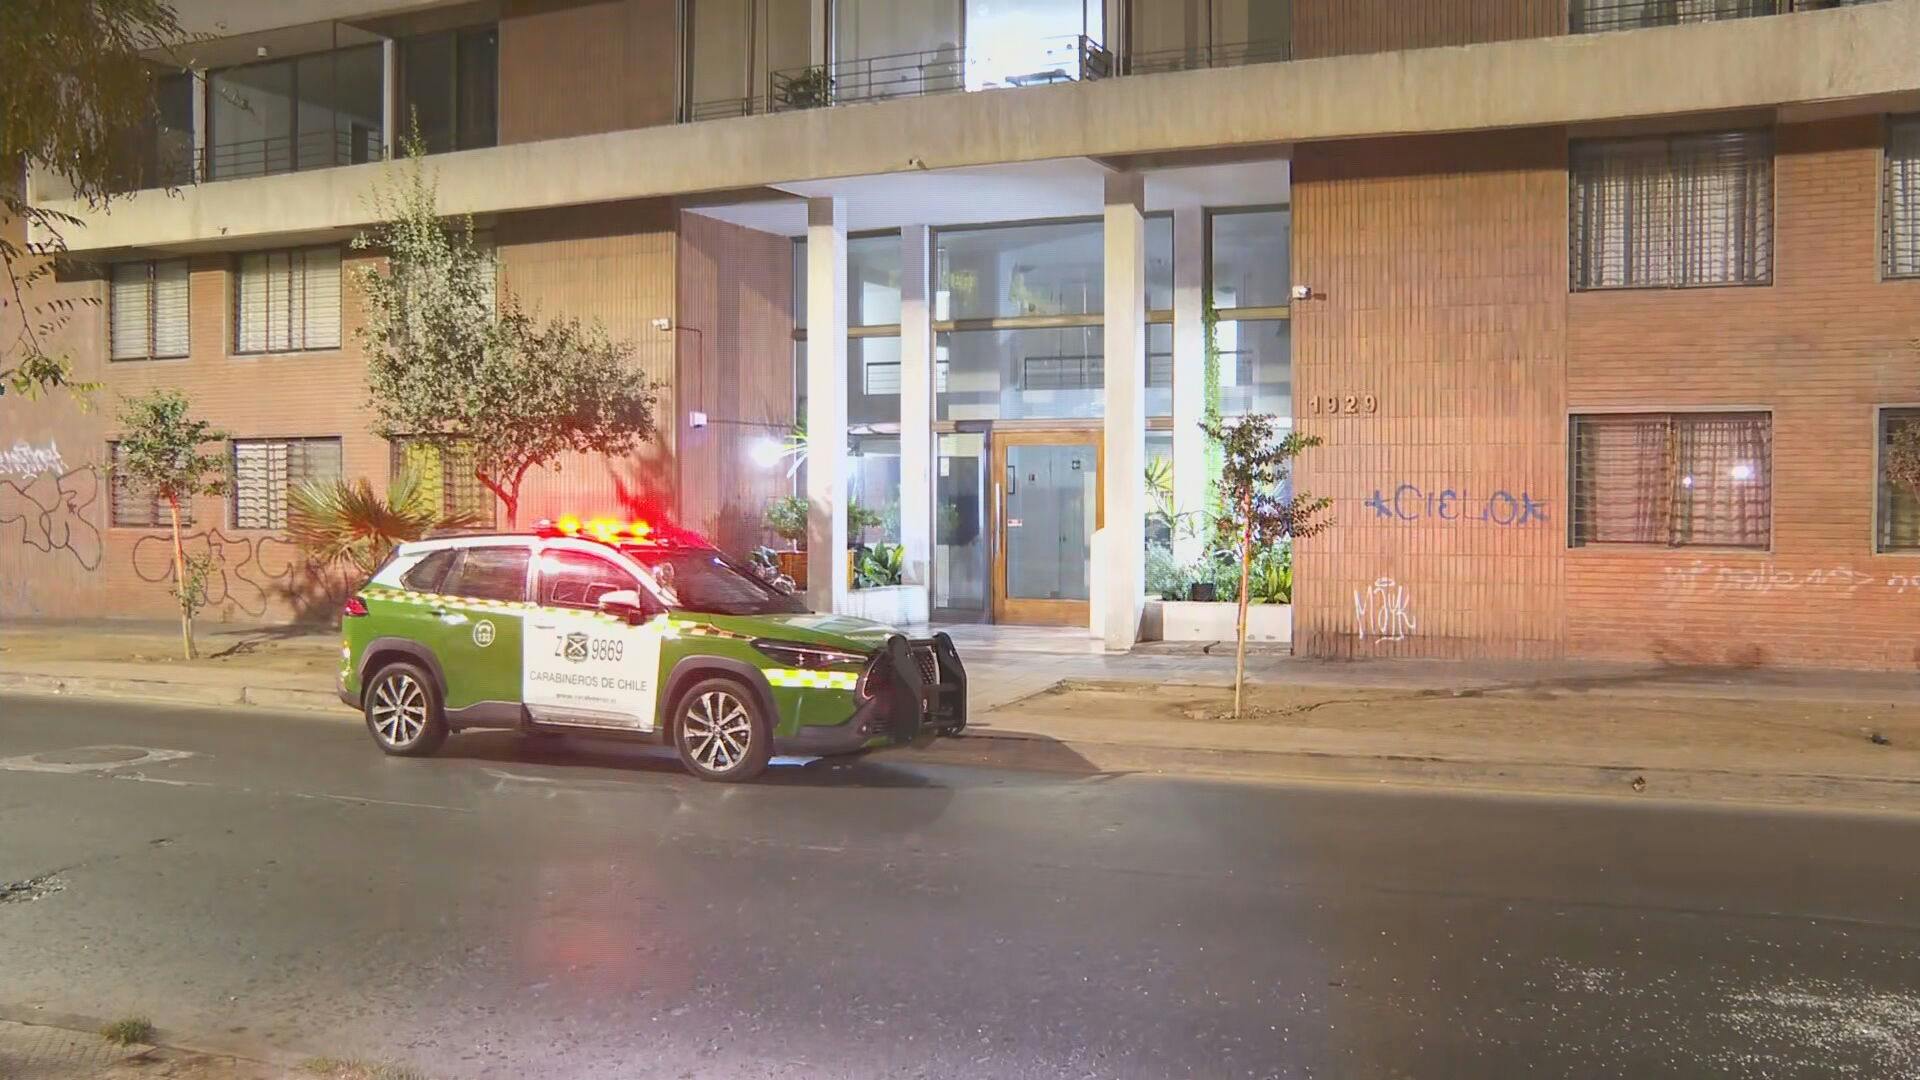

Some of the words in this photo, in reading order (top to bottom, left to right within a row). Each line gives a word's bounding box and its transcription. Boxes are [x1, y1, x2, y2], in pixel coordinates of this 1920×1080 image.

[1309, 395, 1378, 415] 1929
[554, 635, 563, 657] Z
[591, 638, 624, 662] 9869
[529, 670, 599, 688] CARABINEROS
[600, 677, 617, 689] DE
[618, 679, 648, 692] CHILE
